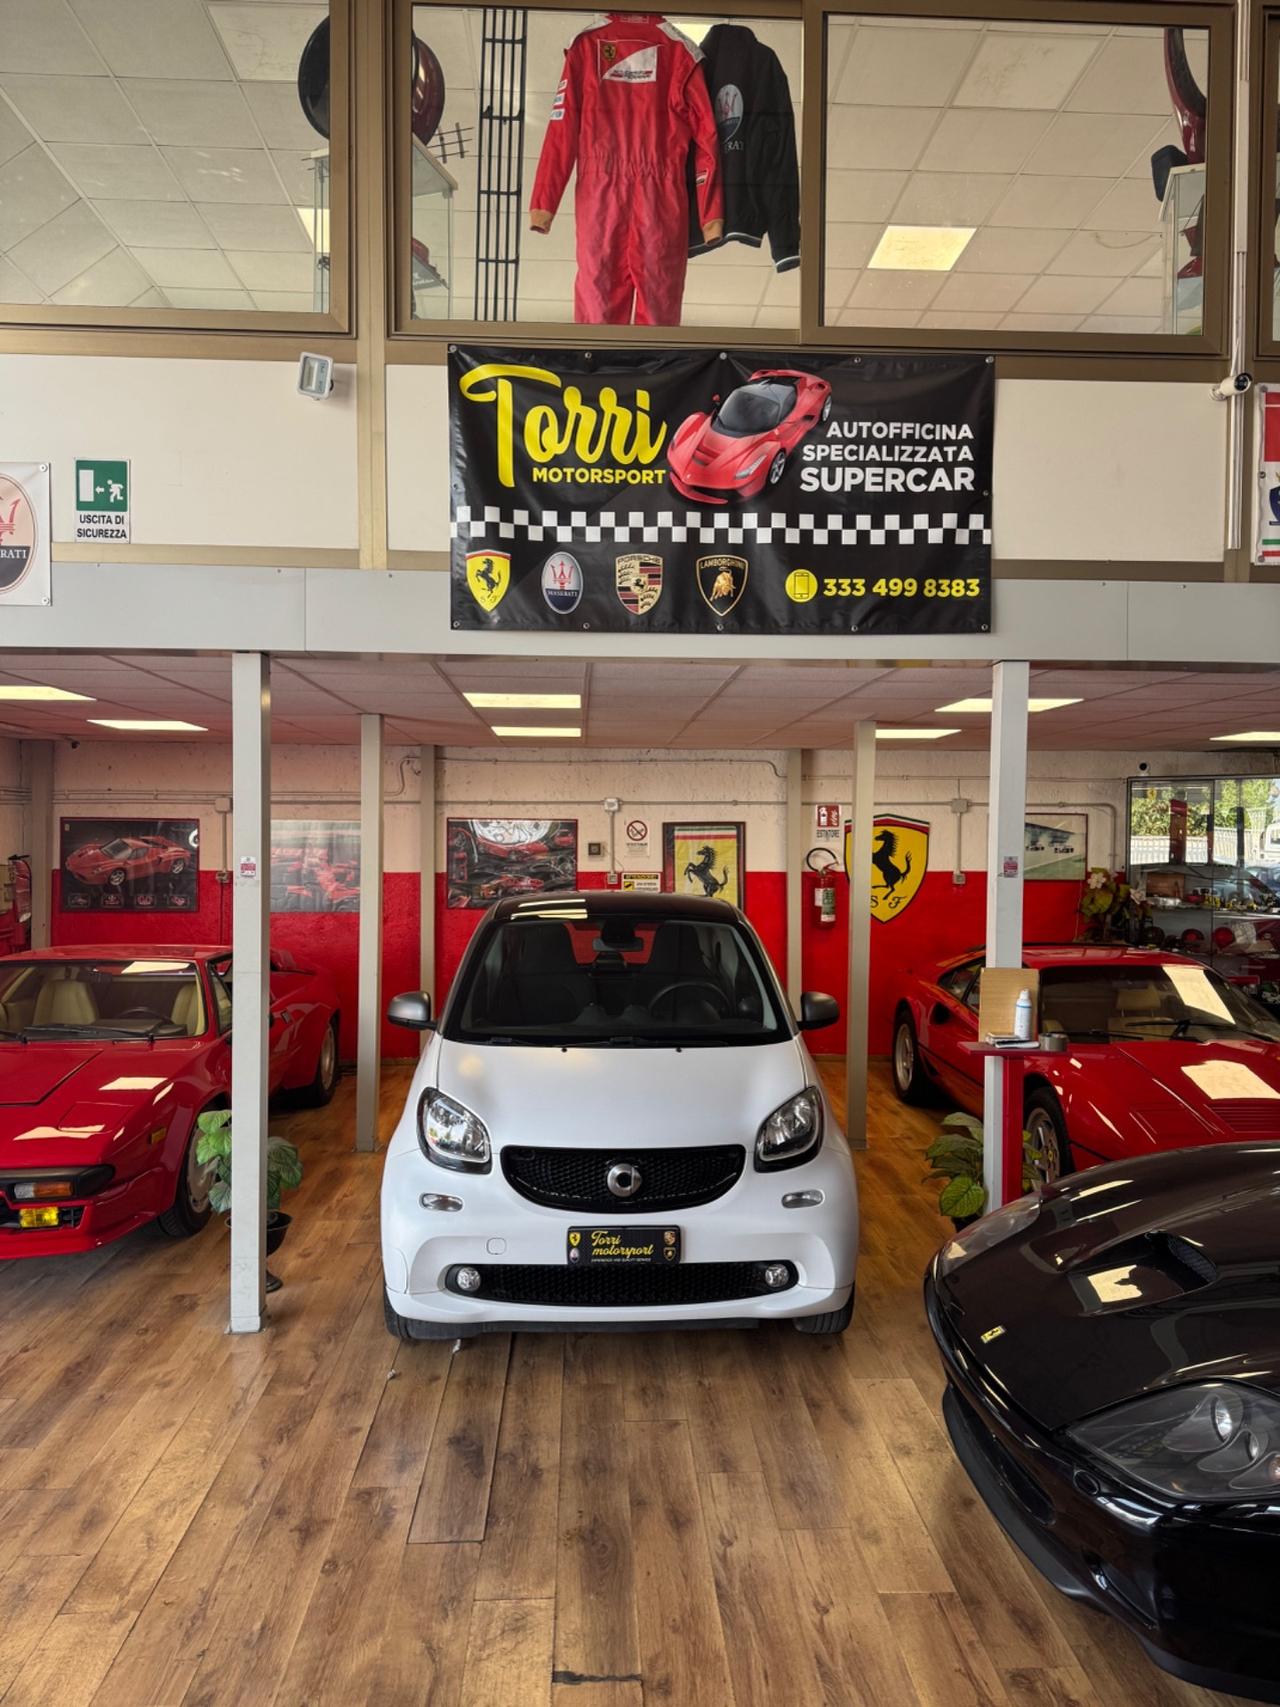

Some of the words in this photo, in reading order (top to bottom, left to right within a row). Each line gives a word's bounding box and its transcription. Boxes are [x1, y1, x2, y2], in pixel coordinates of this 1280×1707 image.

[459, 363, 667, 488] Torri
[826, 421, 974, 440] AUTOFFICINA
[802, 444, 974, 462] SPECIALIZZATA
[532, 467, 665, 484] MOTORSPORT
[799, 466, 975, 493] SUPERCAR
[79, 514, 112, 524] USCITA
[115, 515, 124, 525] DI
[77, 528, 127, 539] SICUREZZA
[0, 549, 26, 559] RATI
[823, 578, 866, 597] 333
[872, 578, 918, 597] 499
[923, 578, 980, 597] 8383
[591, 1230, 620, 1247] Torri
